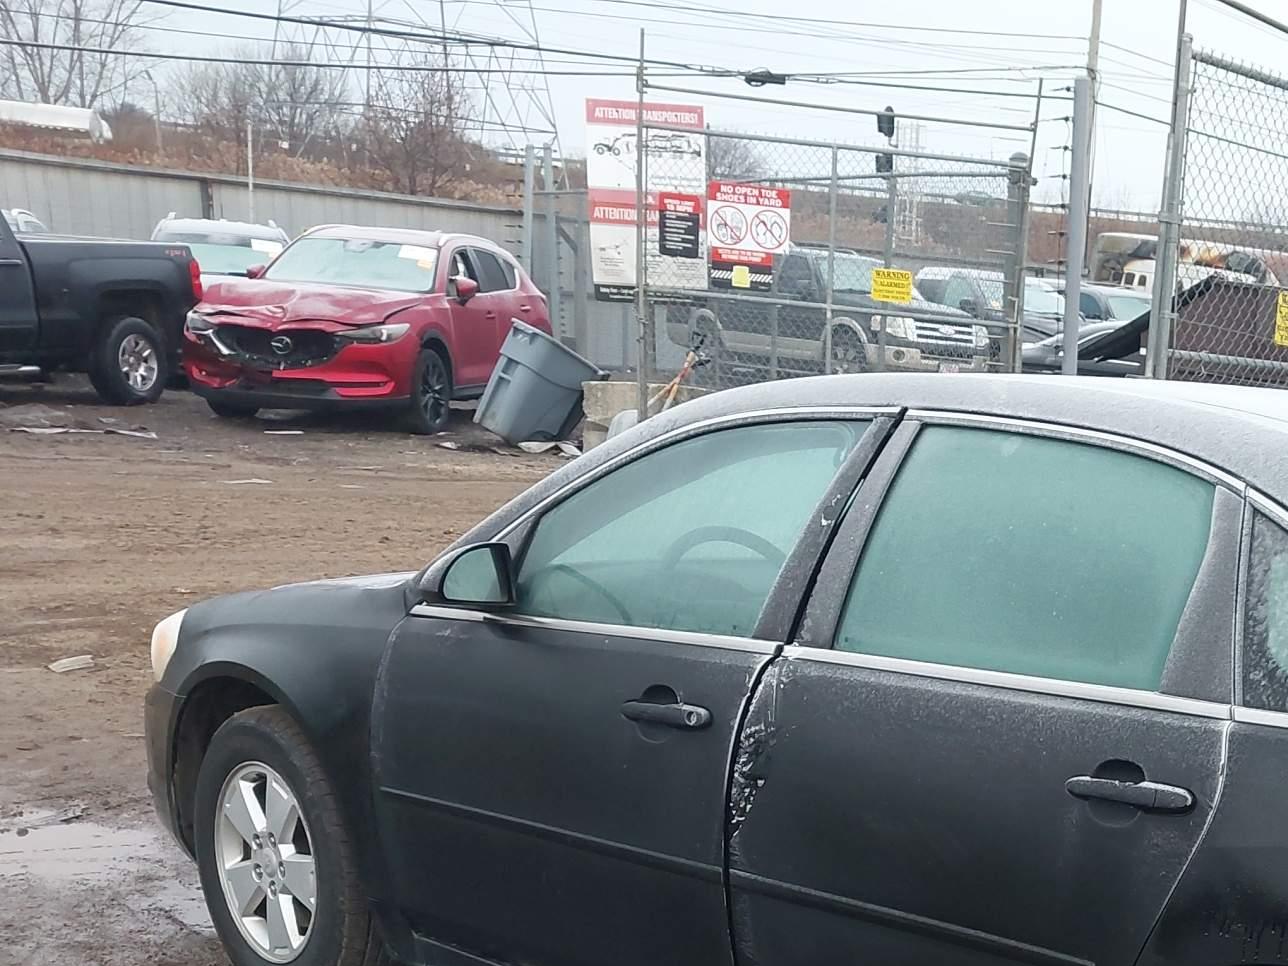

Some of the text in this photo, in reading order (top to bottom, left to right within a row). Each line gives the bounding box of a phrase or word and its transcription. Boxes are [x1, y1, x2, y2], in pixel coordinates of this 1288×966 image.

[594, 106, 698, 124] ATTENTION RANSPORTERS!
[720, 184, 779, 198] NO OPEN TOE
[716, 192, 783, 207] SHOES IN YARD
